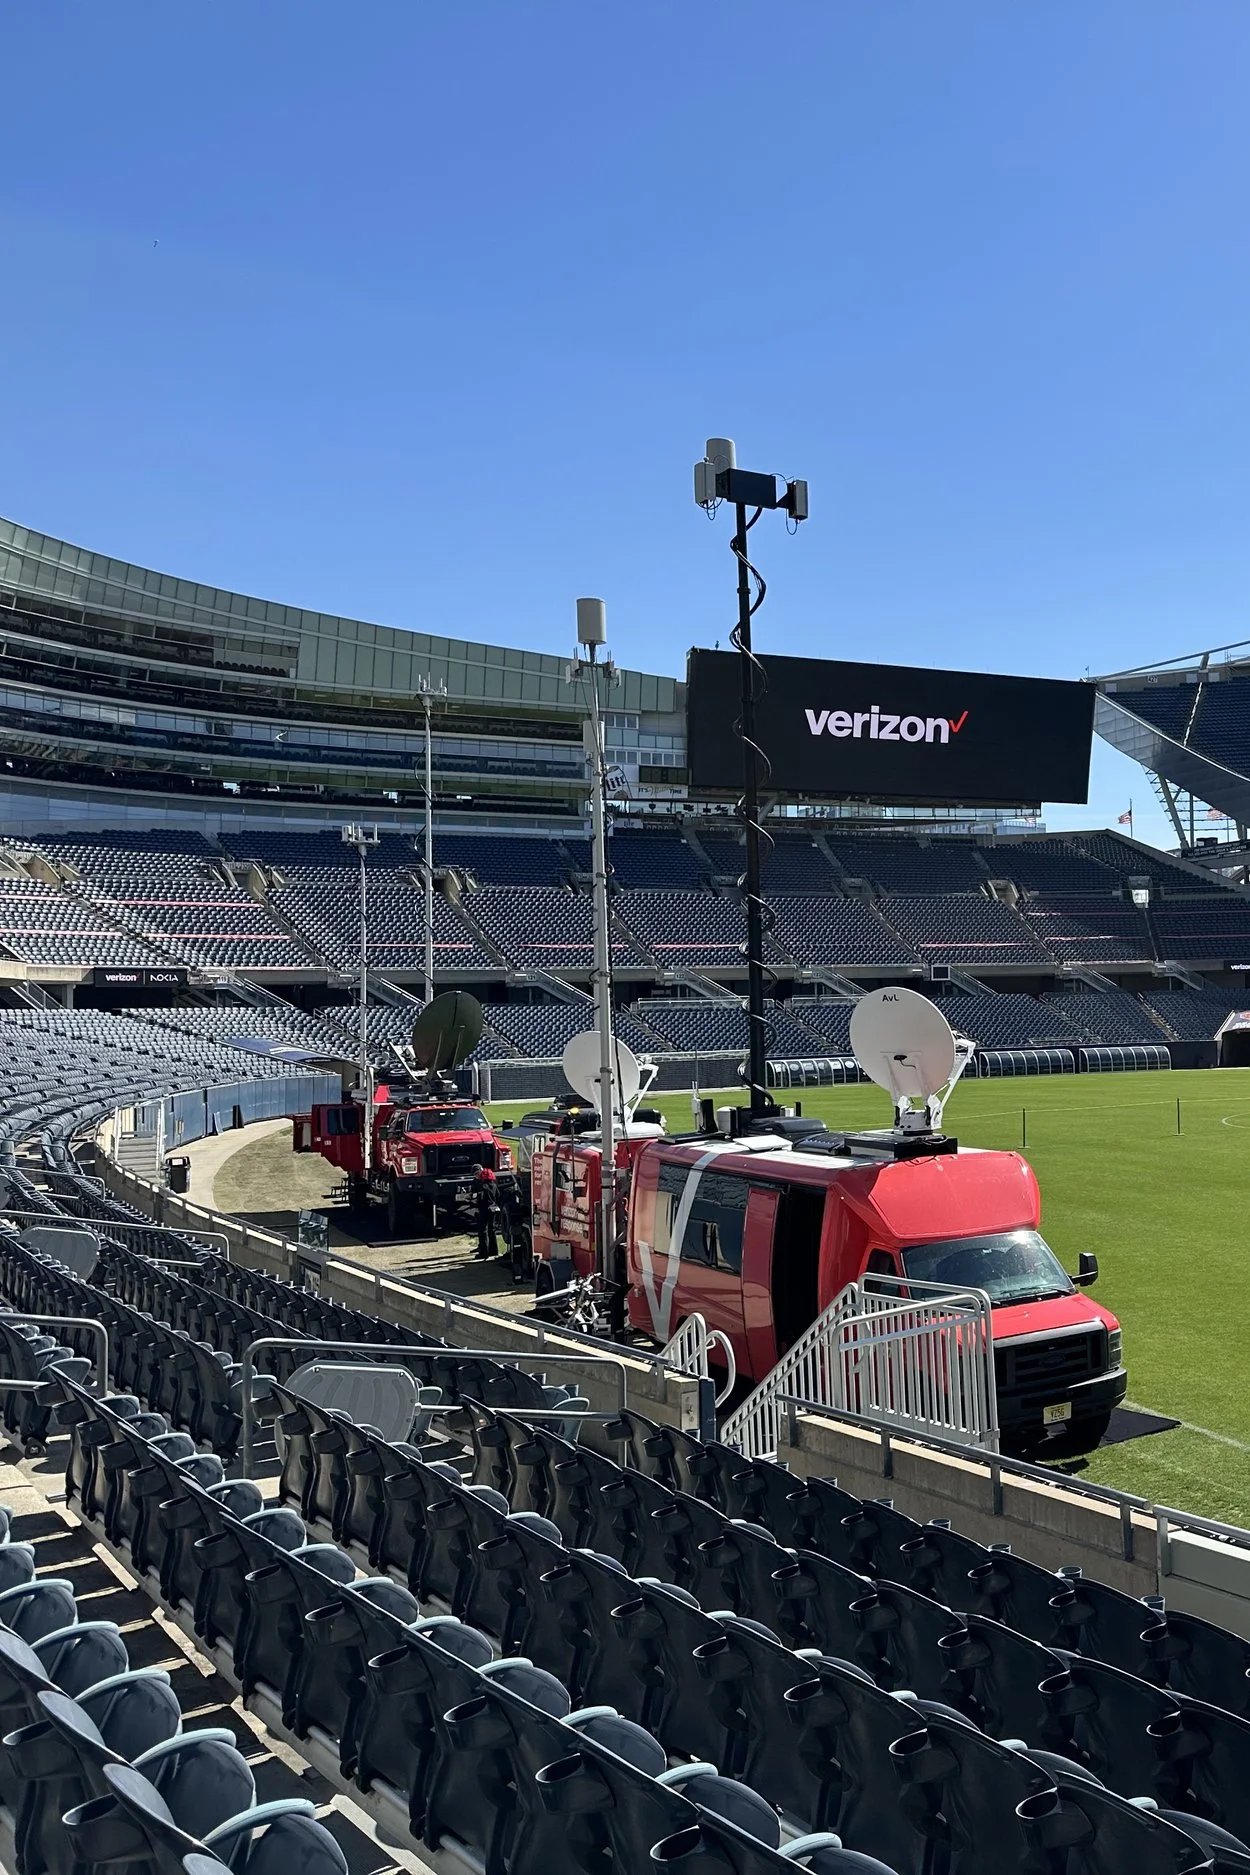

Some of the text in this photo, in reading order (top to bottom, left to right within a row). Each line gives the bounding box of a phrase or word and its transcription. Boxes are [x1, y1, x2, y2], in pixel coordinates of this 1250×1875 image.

[805, 705, 949, 743] verizon
[105, 973, 179, 982] verizon NOKIA
